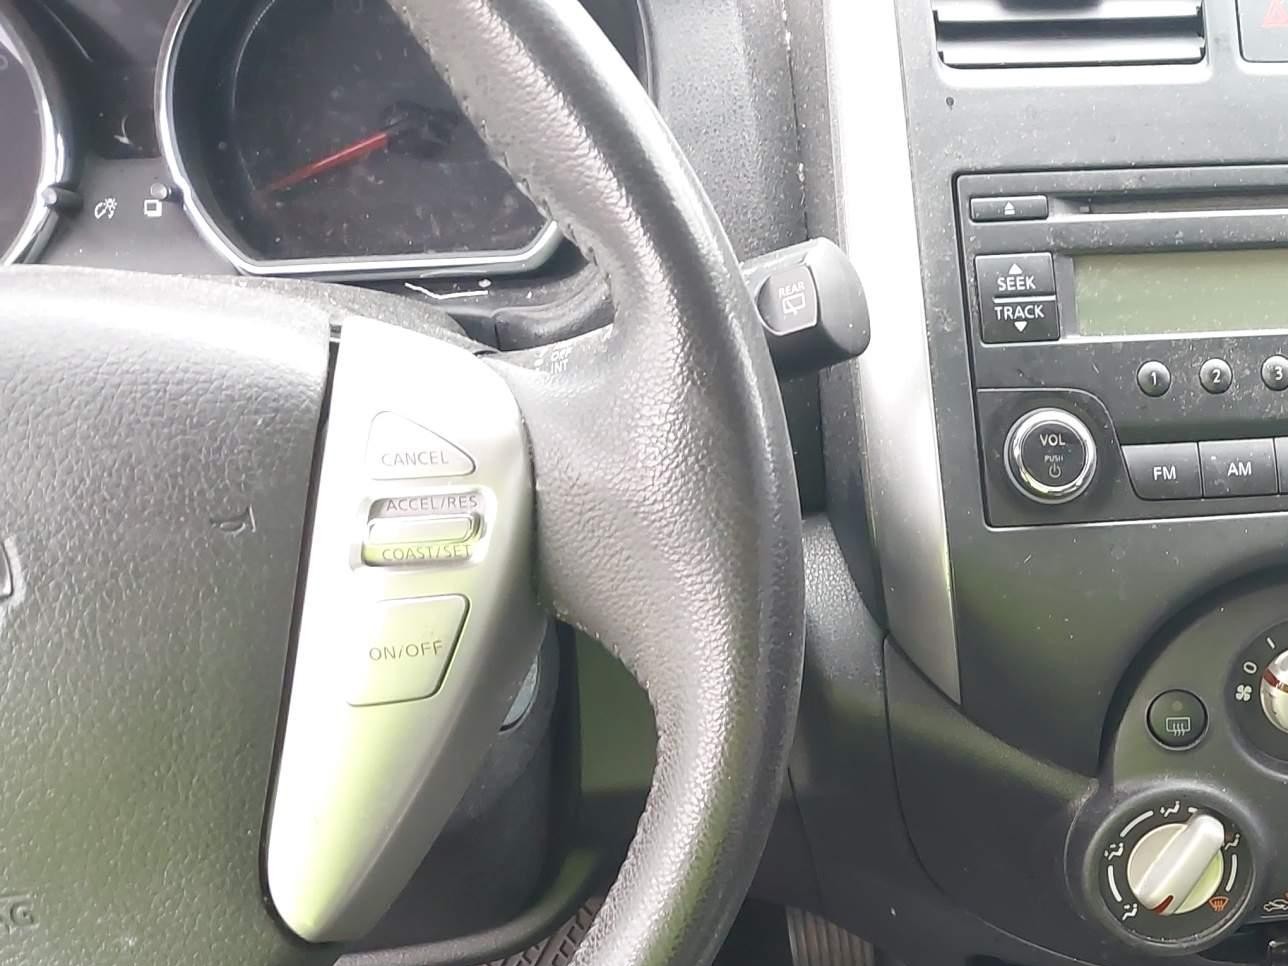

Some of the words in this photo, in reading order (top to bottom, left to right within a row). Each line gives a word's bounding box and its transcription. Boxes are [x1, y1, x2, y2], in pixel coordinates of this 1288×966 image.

[997, 275, 1036, 291] SEEK
[994, 304, 1045, 320] TRACK
[1212, 370, 1222, 384] 2
[1274, 366, 1283, 380] 3
[1040, 433, 1066, 447] VOL
[381, 450, 449, 467] CANCEL
[1044, 455, 1064, 463] PUSH
[1153, 466, 1177, 481] FM
[1227, 461, 1252, 476] AM
[386, 494, 478, 512] ACCEL/RES
[382, 545, 473, 561] COAST/SET
[369, 640, 444, 661] ON/OFF
